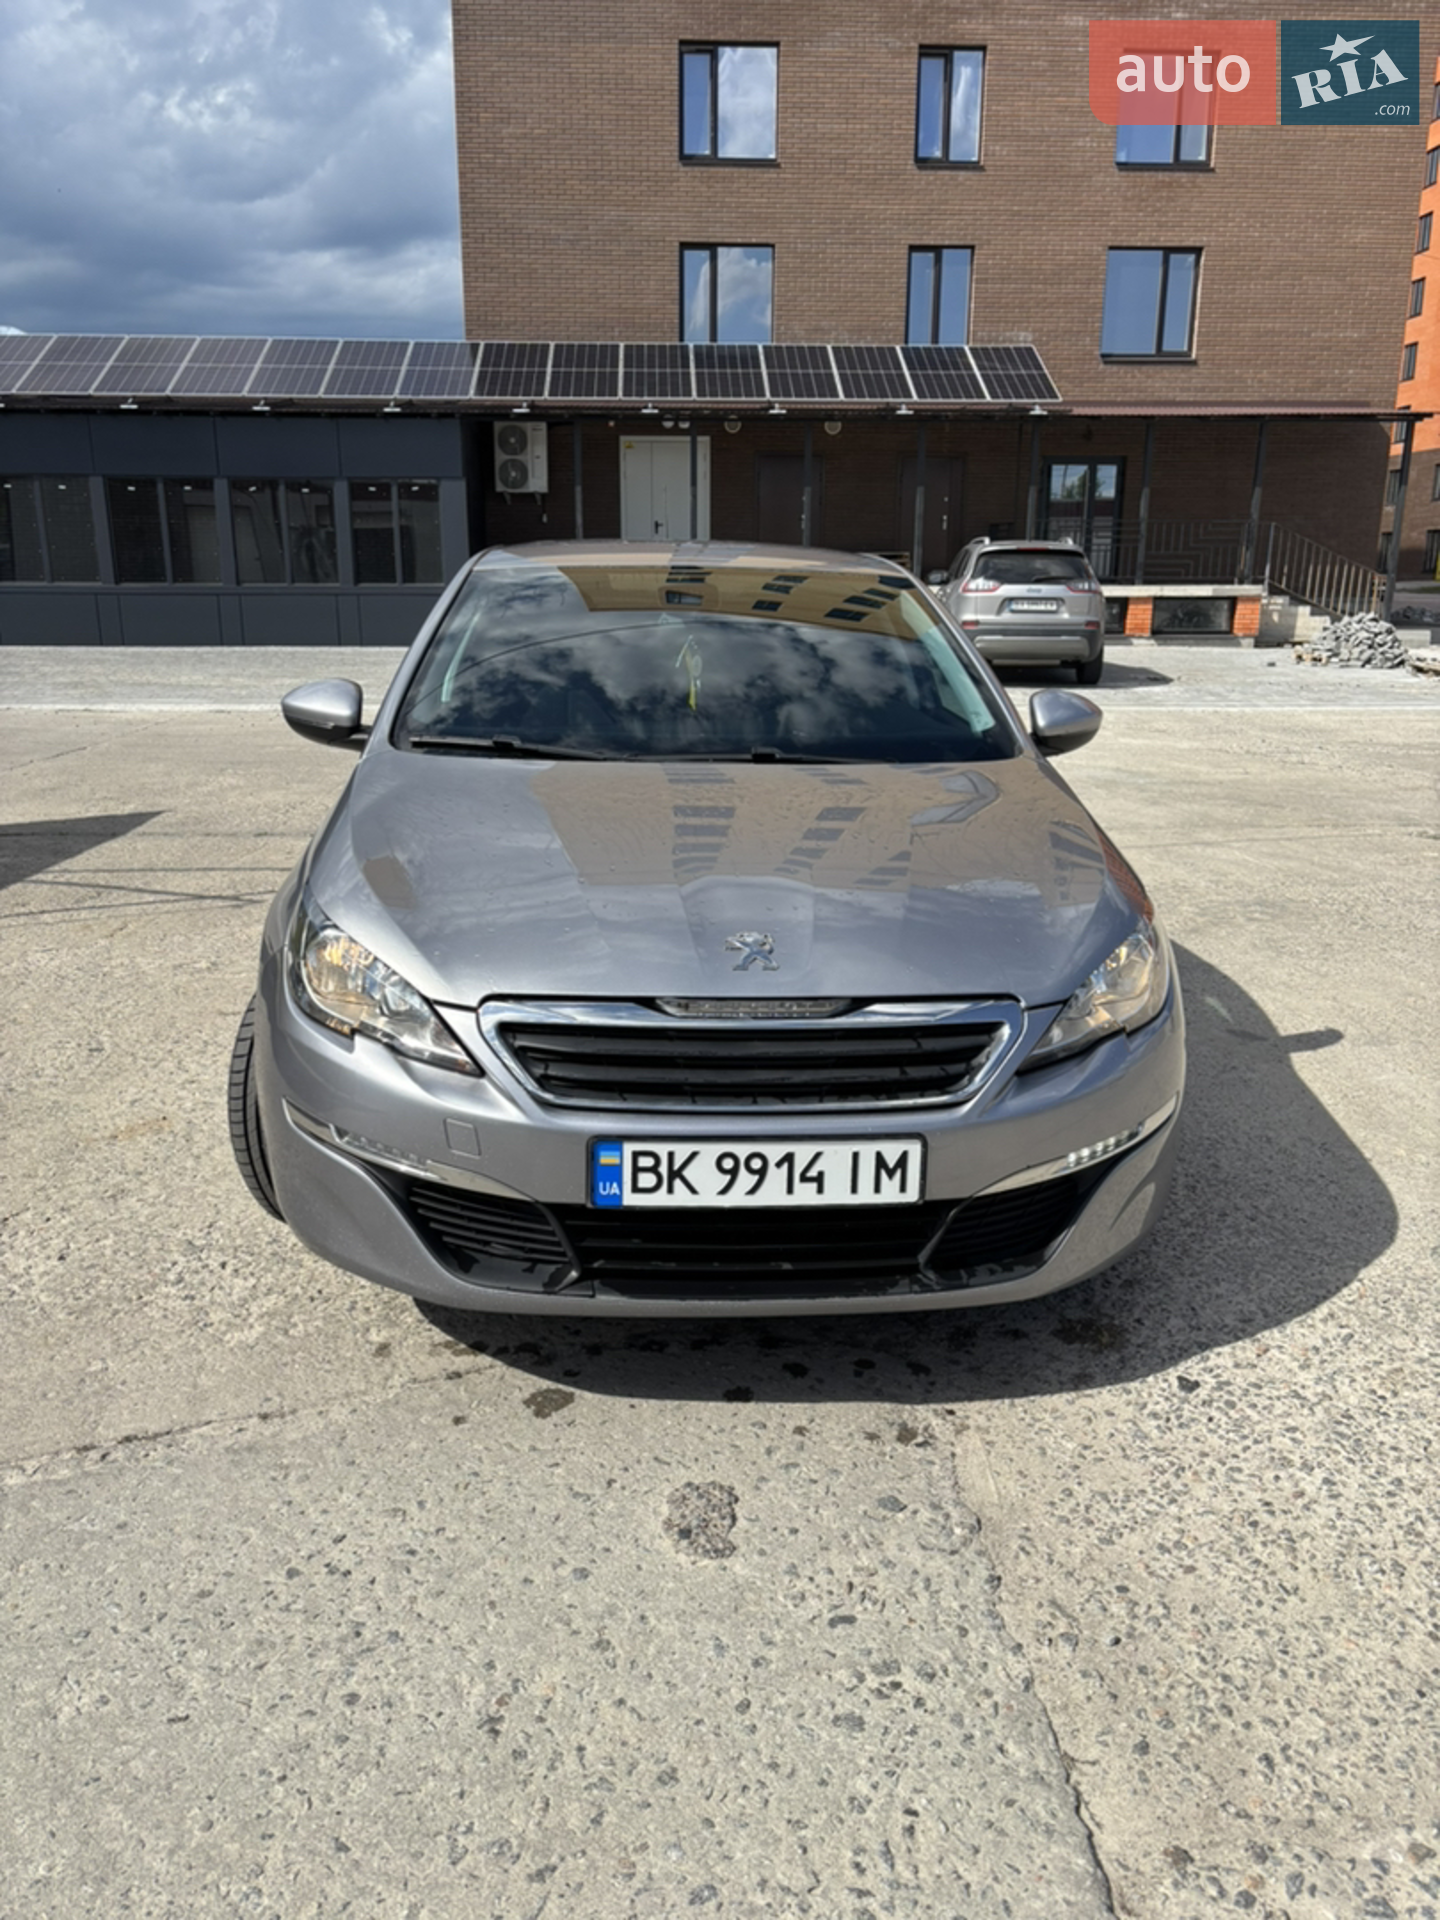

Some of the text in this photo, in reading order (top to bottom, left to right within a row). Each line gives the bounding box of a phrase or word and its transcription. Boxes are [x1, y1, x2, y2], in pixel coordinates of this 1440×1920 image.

[631, 1150, 909, 1195] BK 9914 IM
[599, 1182, 620, 1195] UA
